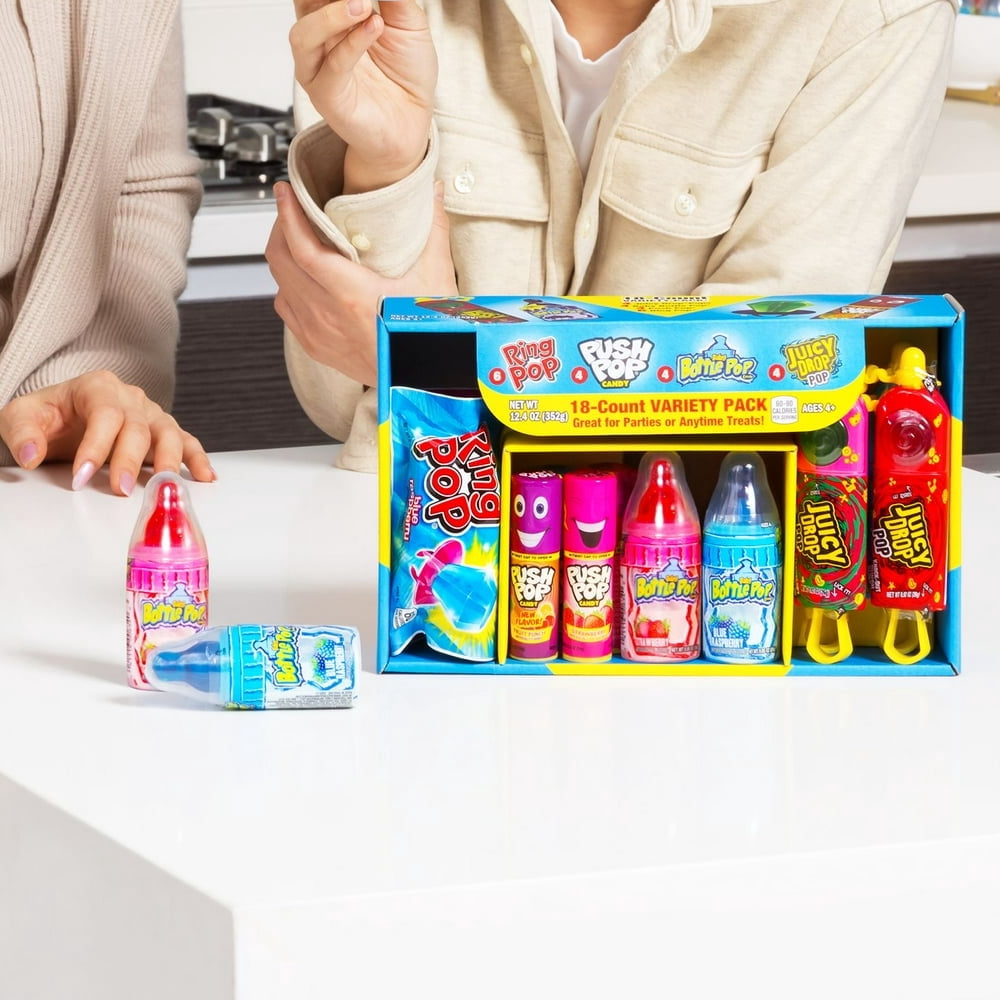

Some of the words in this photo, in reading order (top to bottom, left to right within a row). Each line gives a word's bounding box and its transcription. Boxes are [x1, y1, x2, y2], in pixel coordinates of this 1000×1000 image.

[501, 337, 556, 366] Ring
[578, 337, 655, 364] PUSH
[786, 336, 837, 369] JUICY
[591, 358, 649, 381] POP
[798, 354, 832, 378] DROP
[601, 380, 630, 388] CANDY
[807, 371, 830, 387] POP
[509, 400, 525, 410] NET
[526, 400, 539, 410] WT
[571, 400, 646, 414] 18-Count
[650, 398, 719, 413] VARIETY
[723, 397, 767, 412] PACK
[802, 403, 823, 413] AGES
[825, 404, 835, 413] 4+
[509, 412, 528, 422] 12.4
[529, 412, 540, 421] OZ
[541, 411, 569, 423] (352g)
[573, 418, 601, 428] Great
[605, 417, 620, 427] for
[623, 417, 662, 427] Parties
[665, 418, 677, 427] or
[679, 415, 723, 428] Anytime
[726, 415, 765, 426] Treats!
[457, 427, 499, 522] Ring
[411, 496, 422, 525] blue
[800, 514, 821, 555] DROP
[806, 503, 847, 564] JUICY
[873, 529, 891, 558] POP
[884, 519, 914, 561] DROP
[896, 504, 931, 564] JUICY
[511, 565, 555, 585] PUSH
[567, 564, 613, 586] PUSH
[514, 582, 552, 602] POP
[572, 582, 610, 602] POP
[713, 627, 727, 638] BLUE
